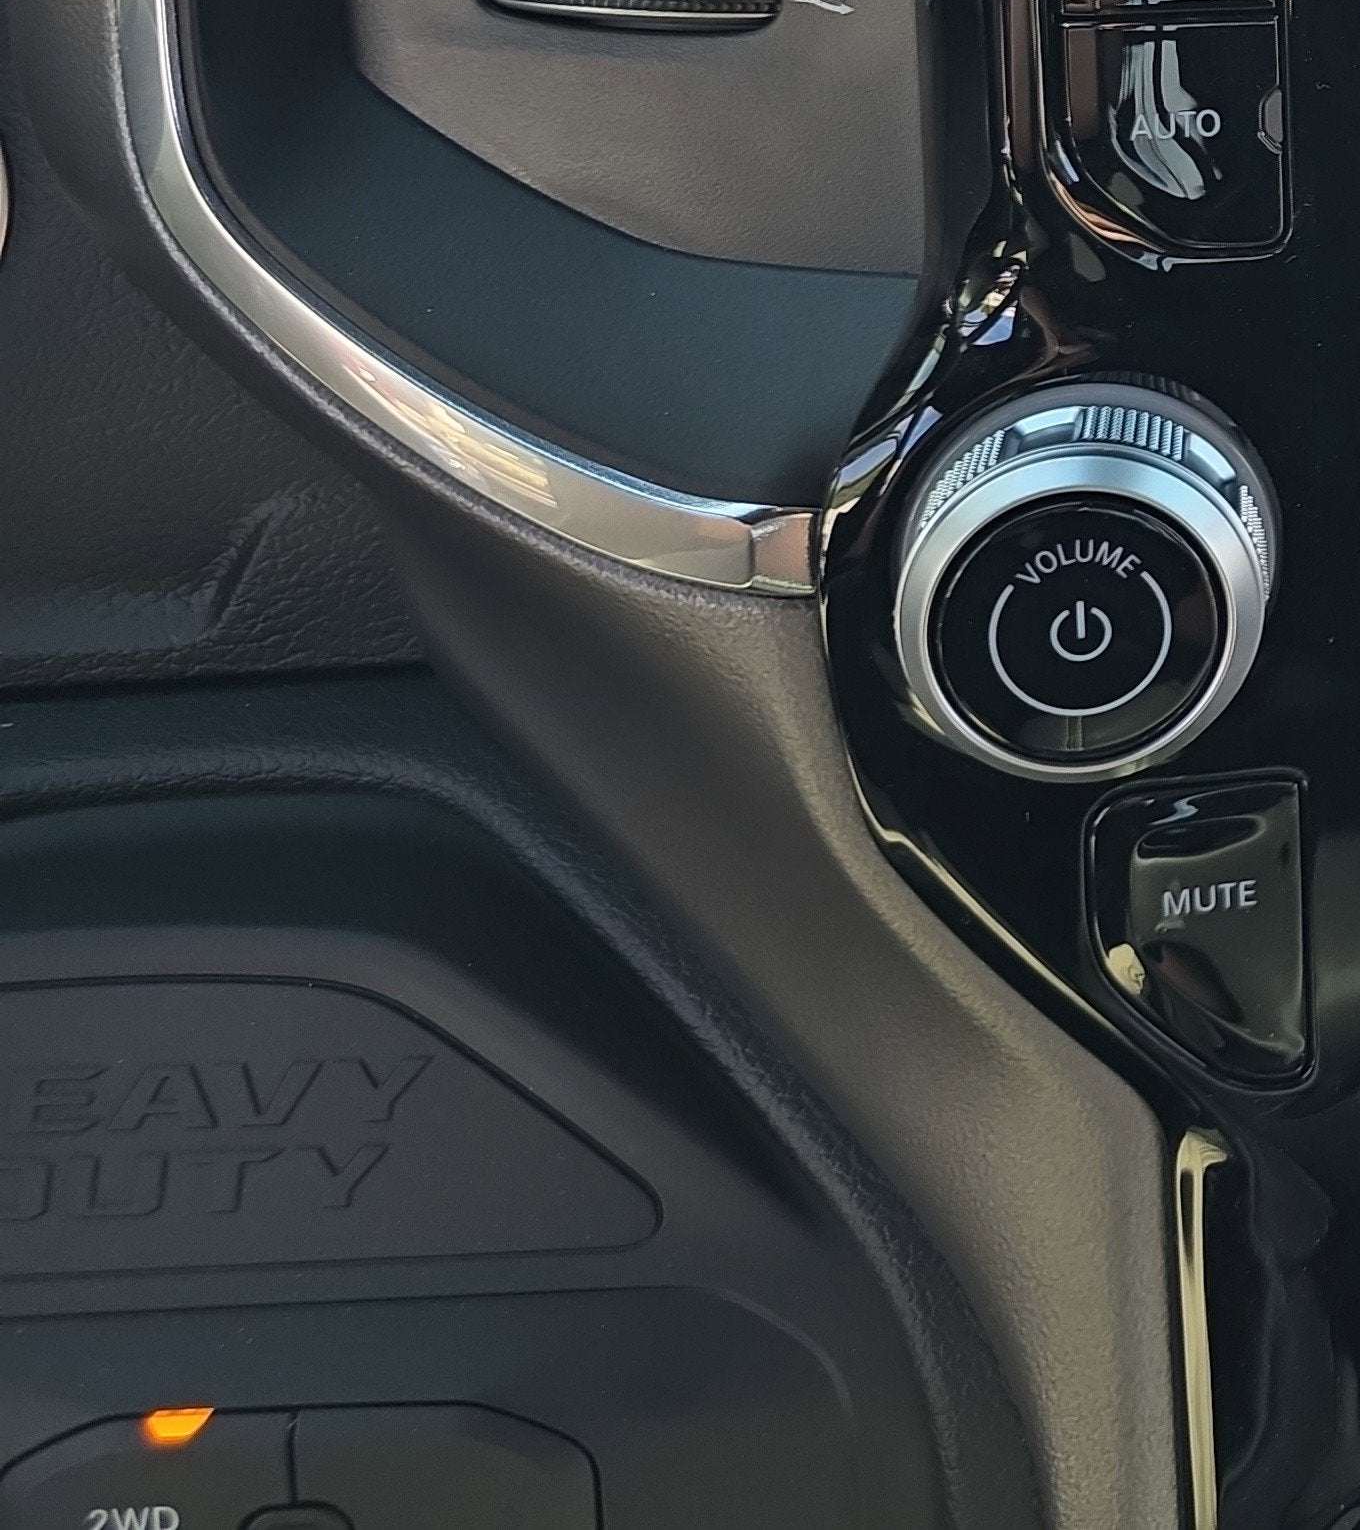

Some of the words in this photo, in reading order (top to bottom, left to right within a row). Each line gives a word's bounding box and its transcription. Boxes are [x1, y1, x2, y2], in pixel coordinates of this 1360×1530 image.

[1129, 108, 1222, 142] AUTO
[1014, 538, 1143, 586] VOLUME
[1161, 878, 1258, 918] MUTE
[2, 1054, 437, 1139] EAVY
[88, 1506, 180, 1530] 2WD
